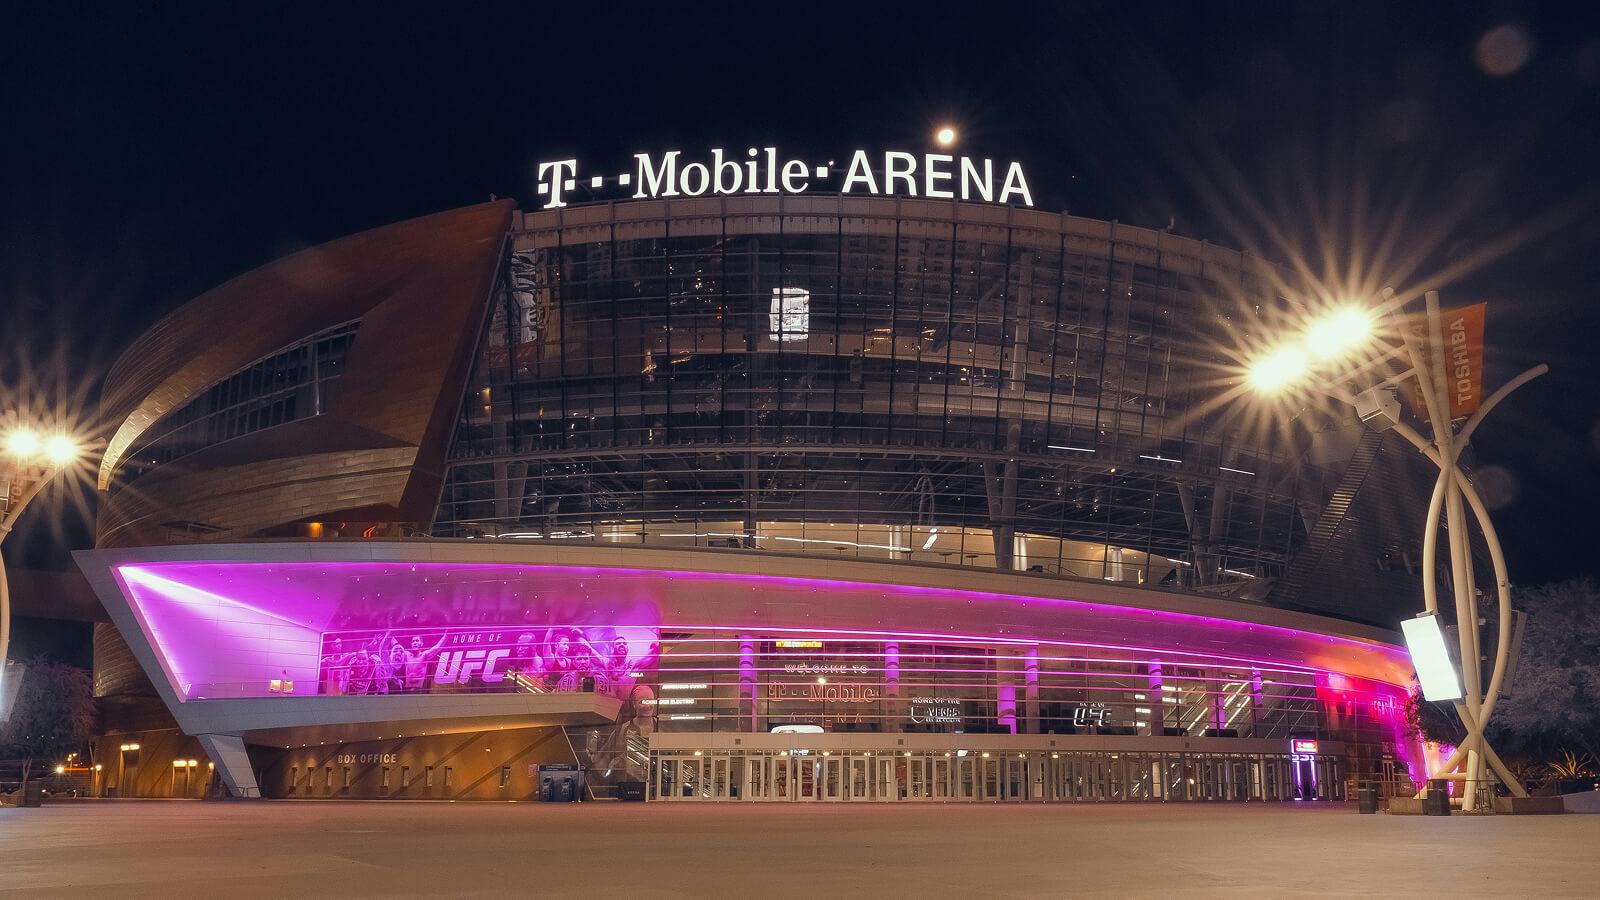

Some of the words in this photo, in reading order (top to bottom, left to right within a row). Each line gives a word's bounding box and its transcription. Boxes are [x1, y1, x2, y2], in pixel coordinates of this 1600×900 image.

[841, 150, 1034, 207] ARENA
[1450, 317, 1473, 406] TOSHIBA
[453, 634, 482, 644] HOME
[488, 633, 502, 642] OF
[434, 649, 511, 683] UFC
[785, 664, 848, 674] WELCOME
[852, 664, 869, 674] TO
[338, 754, 357, 764] BOX
[360, 753, 397, 764] OFFICE
